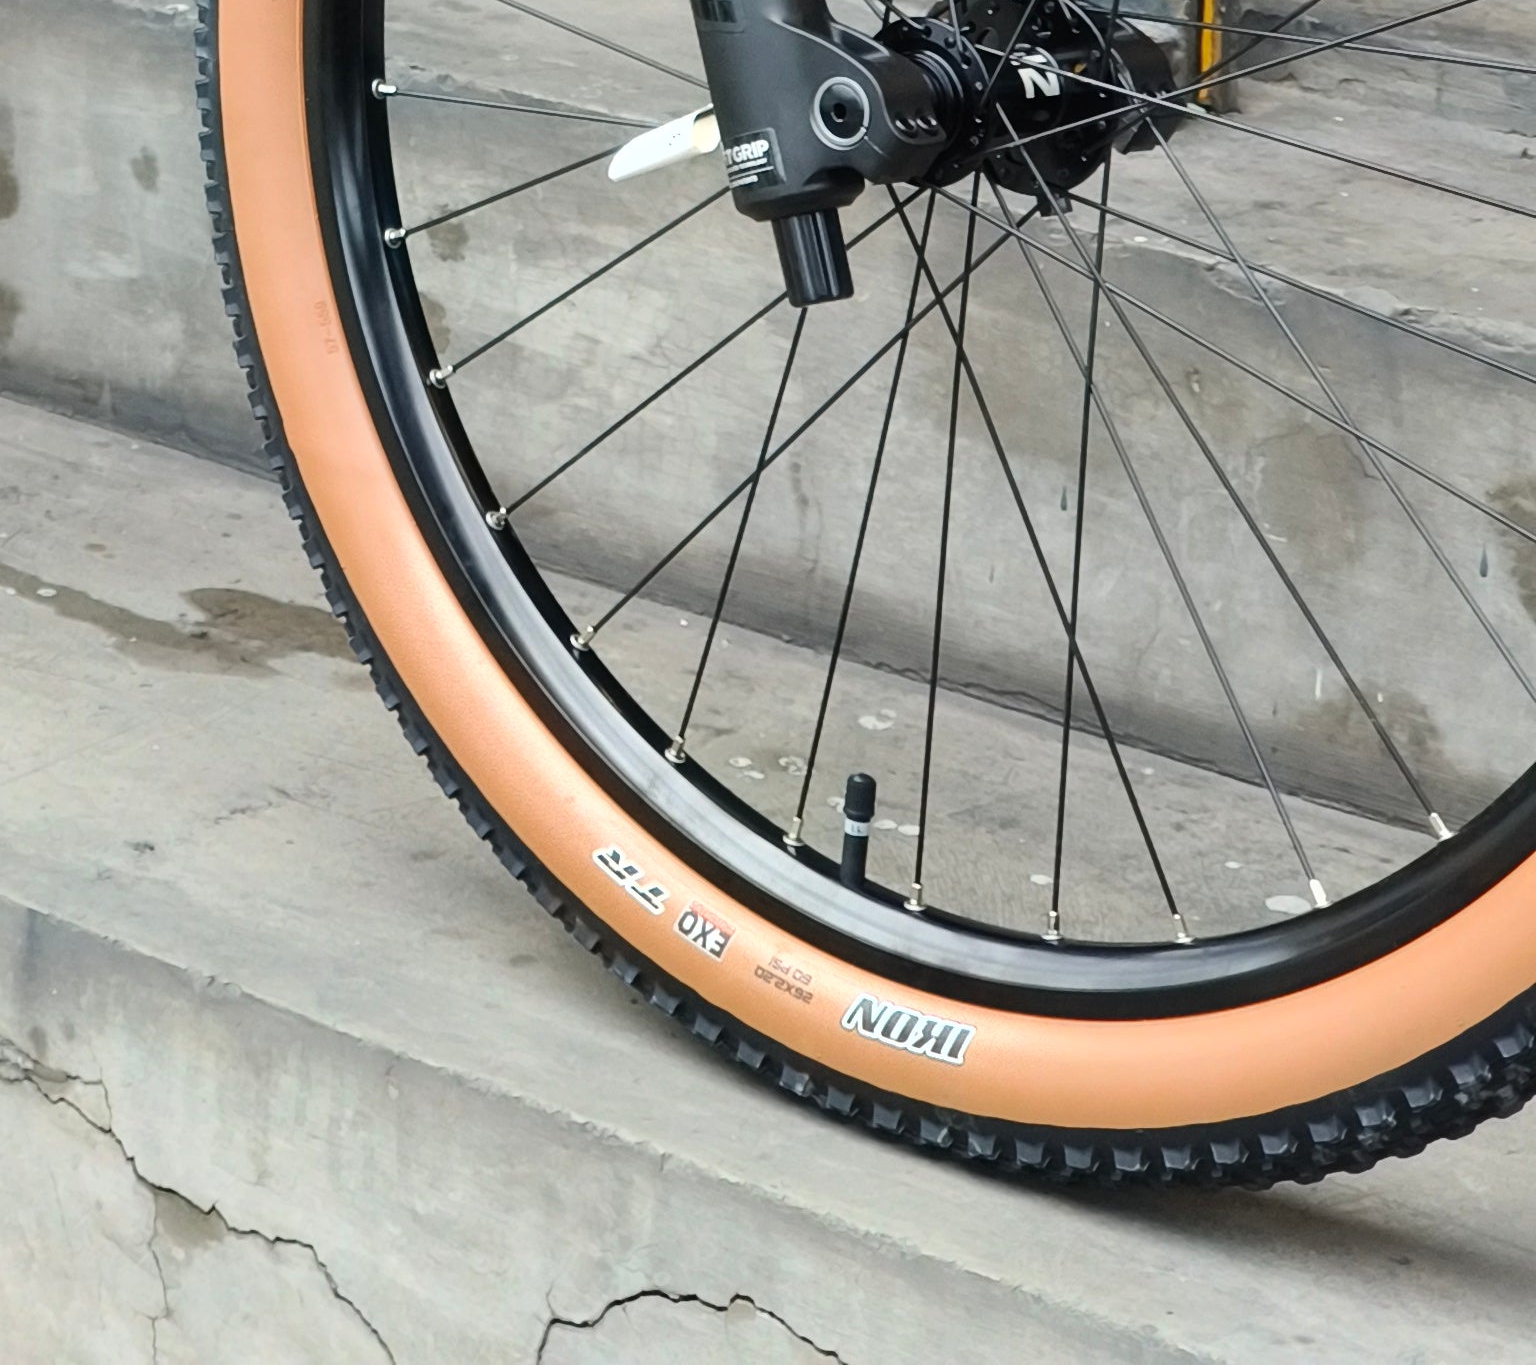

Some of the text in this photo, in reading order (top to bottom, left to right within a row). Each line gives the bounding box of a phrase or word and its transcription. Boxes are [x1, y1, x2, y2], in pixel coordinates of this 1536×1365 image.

[592, 846, 670, 915] TR
[676, 909, 732, 960] EXO
[767, 954, 791, 976] PSI
[841, 994, 977, 1065] IKON
